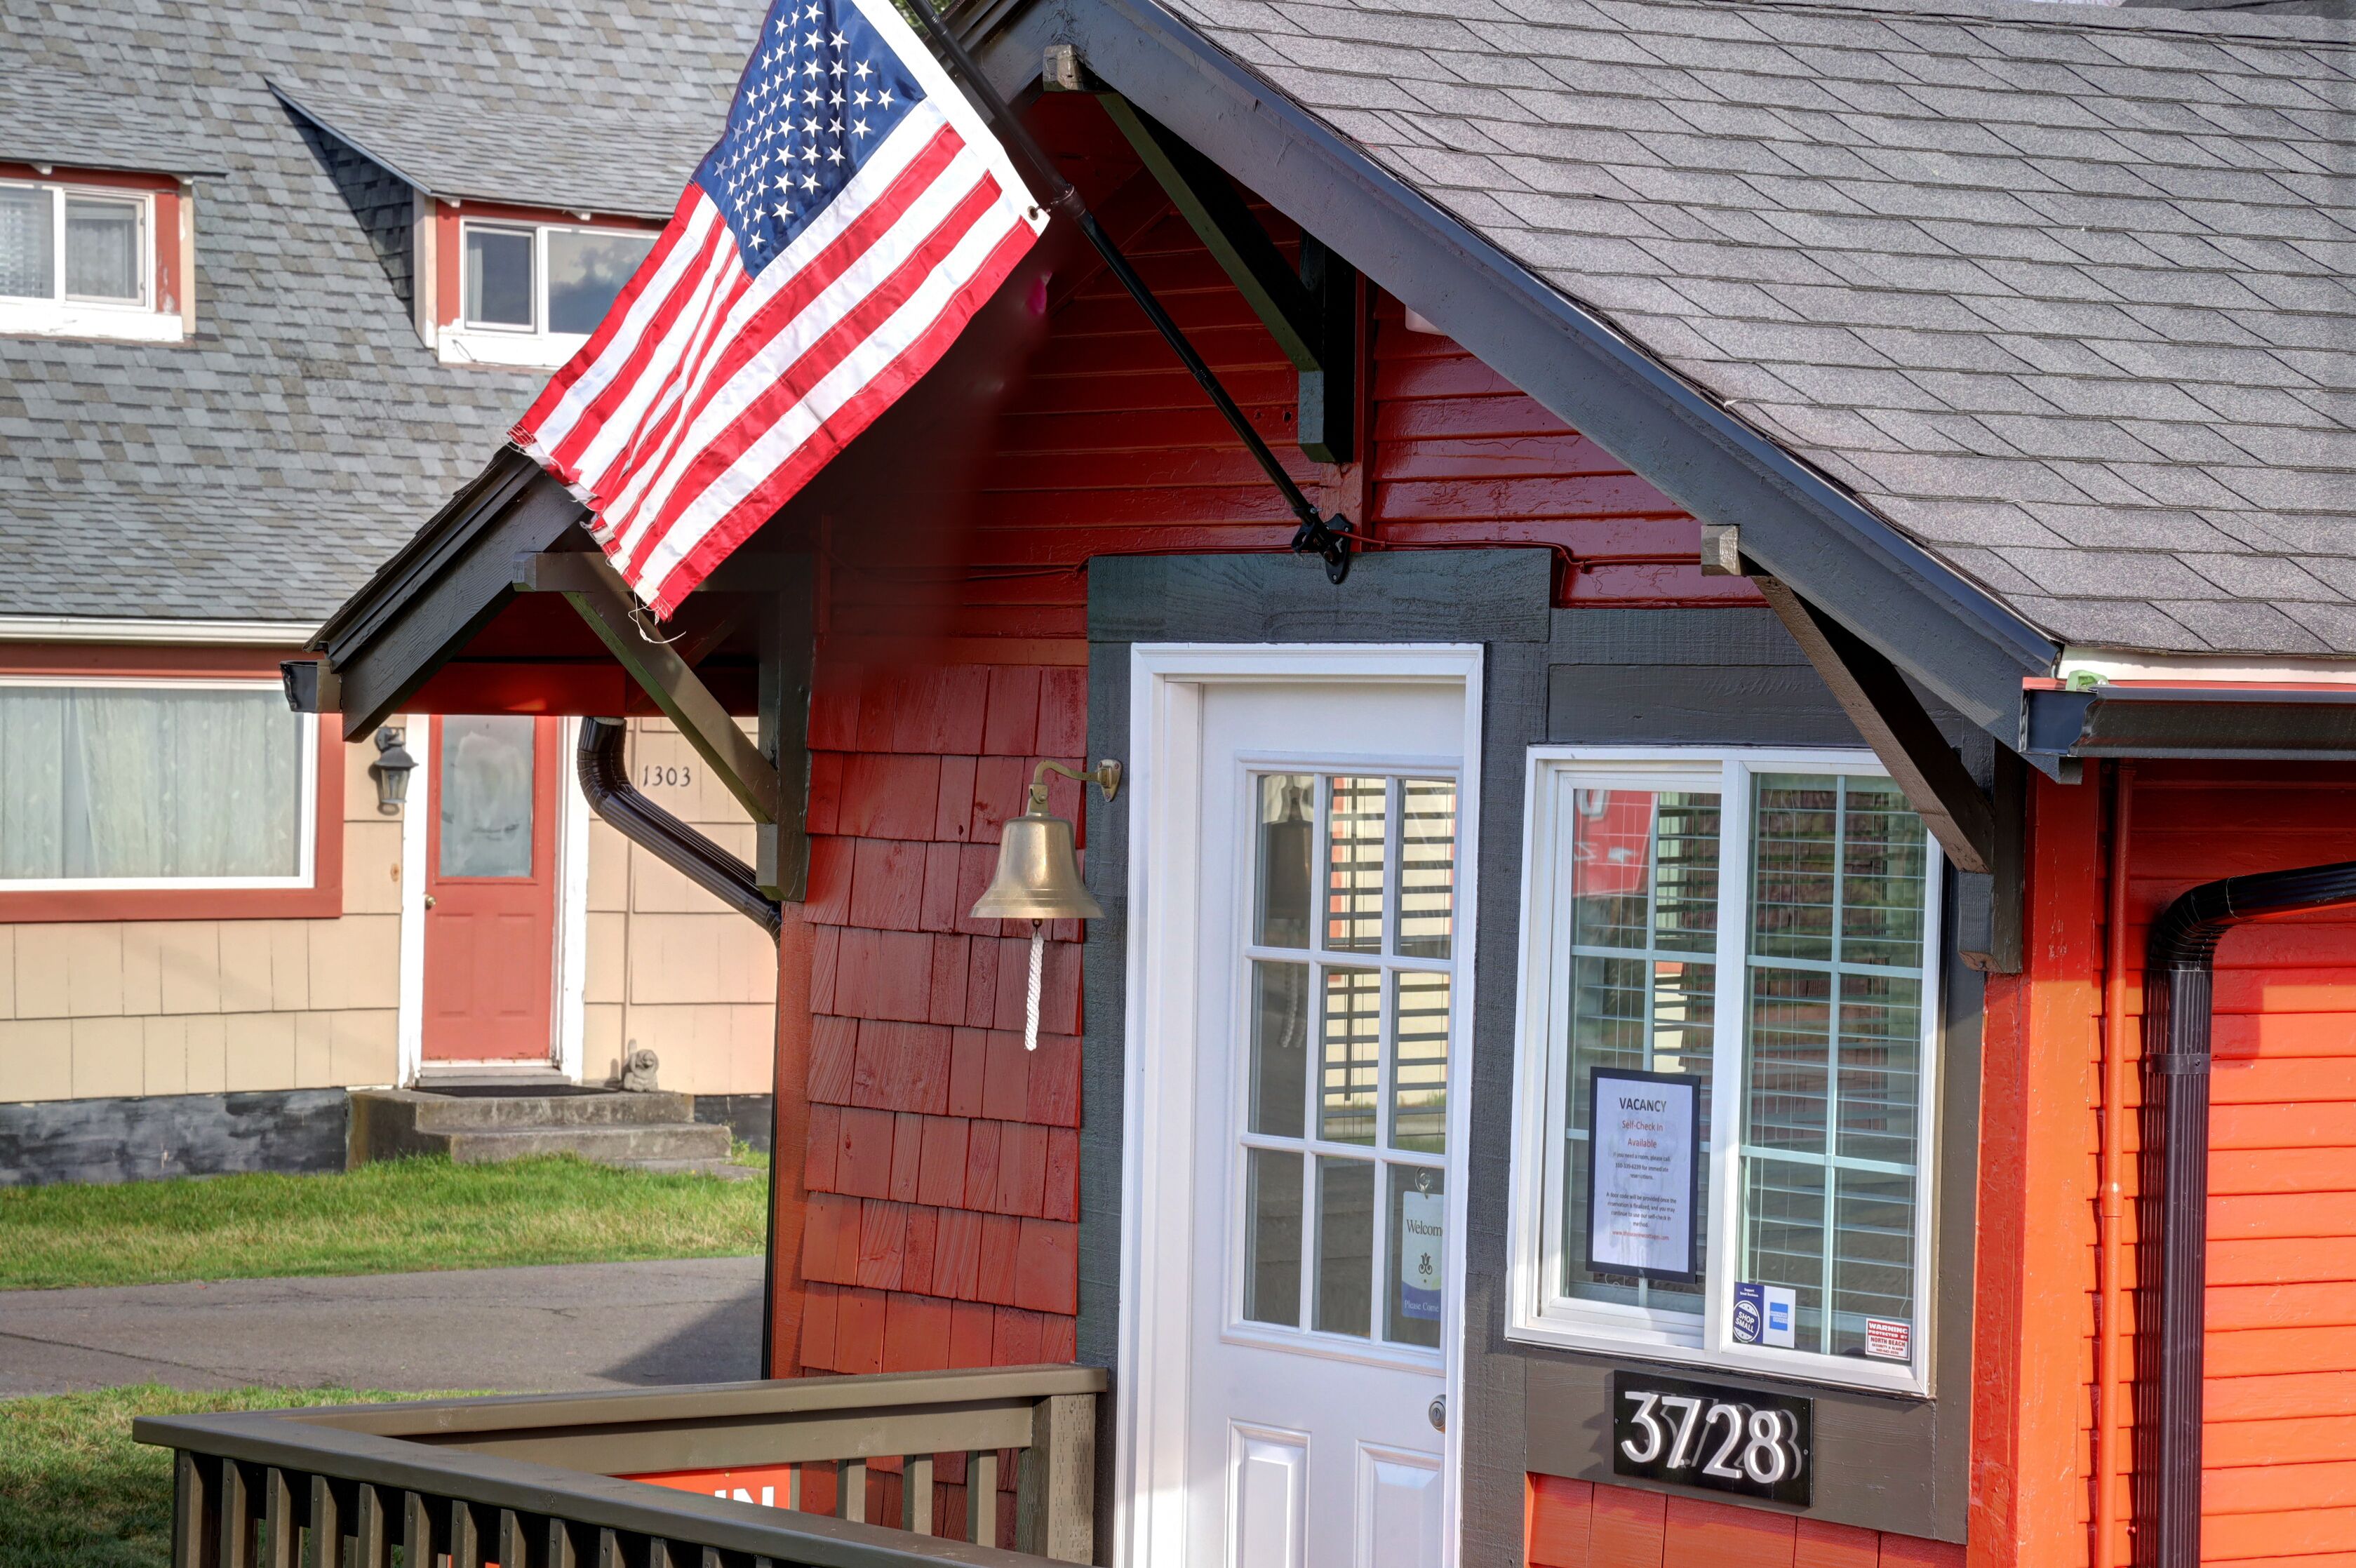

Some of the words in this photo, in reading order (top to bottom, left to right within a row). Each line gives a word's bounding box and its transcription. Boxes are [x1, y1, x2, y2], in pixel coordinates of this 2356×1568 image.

[643, 765, 690, 787] 1303
[1619, 1097, 1666, 1113] VACANCY
[1622, 1120, 1656, 1132] Self-Check
[1657, 1123, 1663, 1132] In
[1628, 1138, 1657, 1148] Available
[1405, 1300, 1421, 1310] Please
[1423, 1302, 1439, 1312] Come
[1739, 1311, 1755, 1325] SHOP
[1735, 1318, 1754, 1333] SMALL
[1869, 1322, 1908, 1334] WARNING
[1621, 1391, 1785, 1484] 3728
